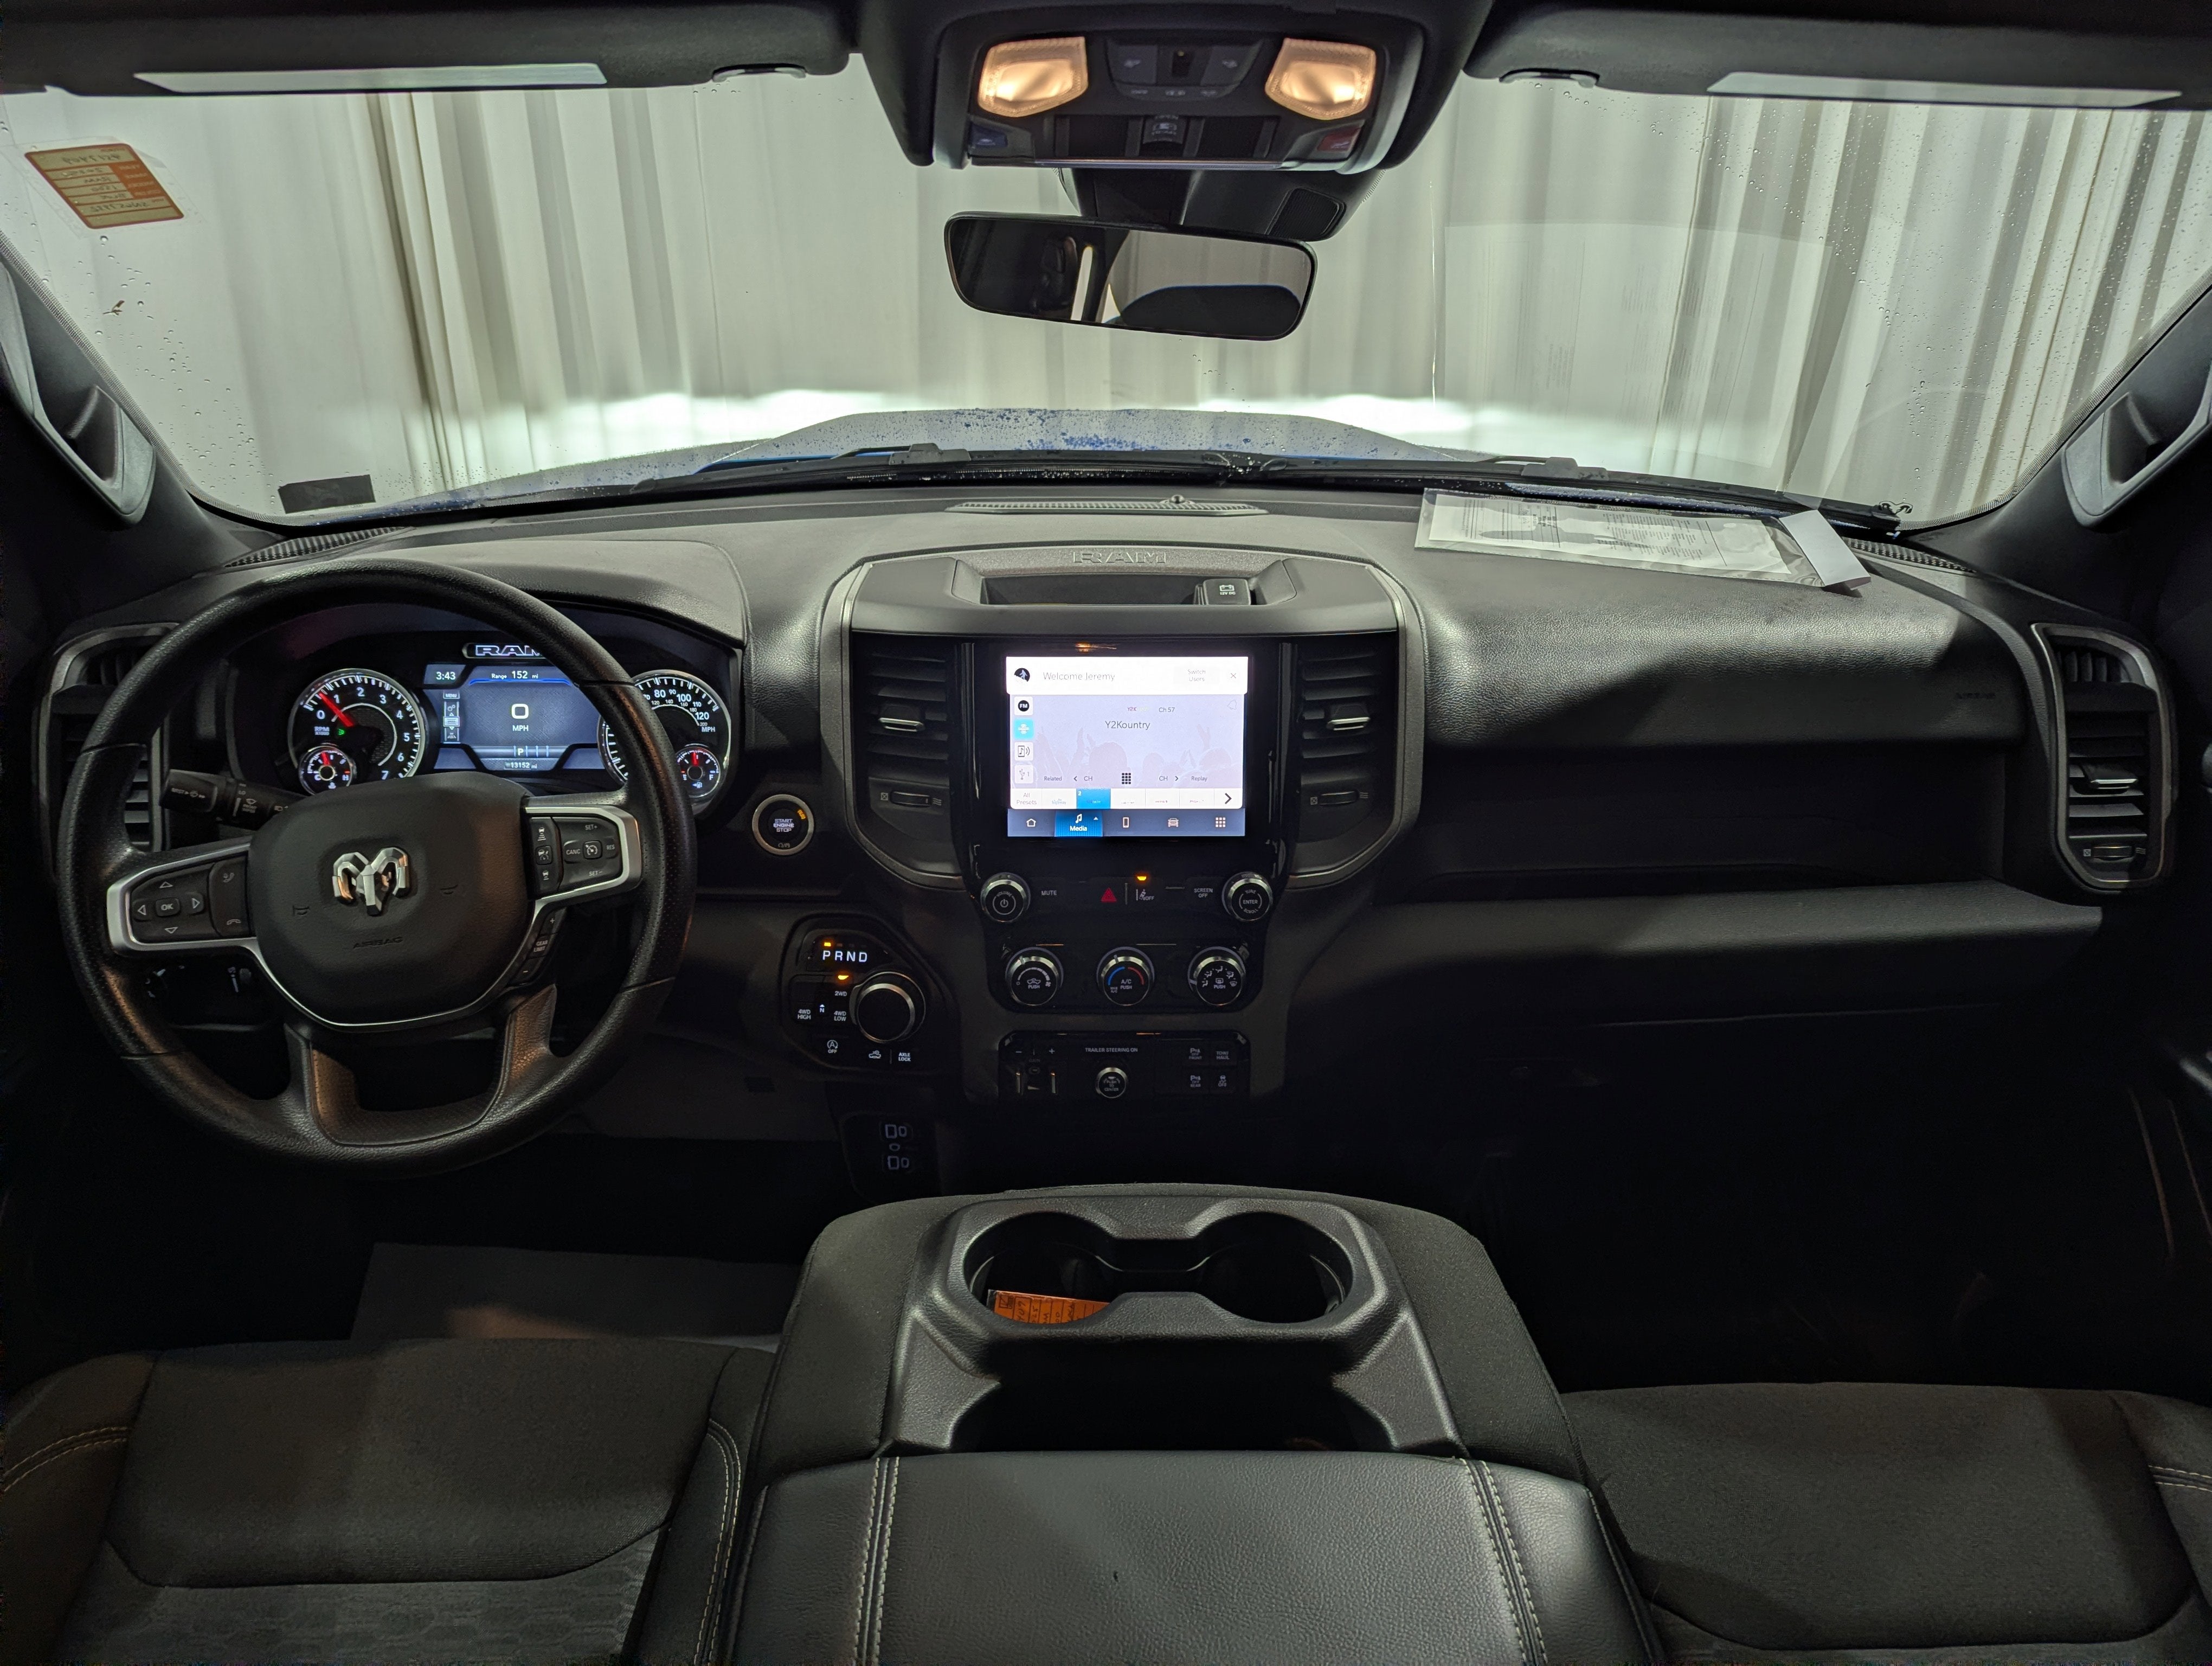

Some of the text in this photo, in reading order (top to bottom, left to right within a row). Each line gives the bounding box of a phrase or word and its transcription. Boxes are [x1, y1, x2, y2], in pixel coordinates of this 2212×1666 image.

[1073, 552, 1166, 564] RAM
[436, 672, 455, 680] 3:43
[512, 671, 528, 679] 152
[1043, 672, 1115, 682] Welcome Jeremy
[357, 687, 365, 697] 2
[654, 690, 666, 698] 80
[334, 695, 340, 703] 1
[380, 695, 387, 704] 3
[677, 694, 691, 702] 100
[317, 710, 325, 720] 0
[396, 710, 403, 719] 4
[512, 703, 529, 719] 0
[696, 712, 710, 720] 120
[1105, 721, 1150, 731] Y2Kountry
[404, 733, 410, 741] 5
[397, 753, 404, 761] 6
[382, 771, 389, 780] 7
[353, 936, 404, 949] AIRBAG
